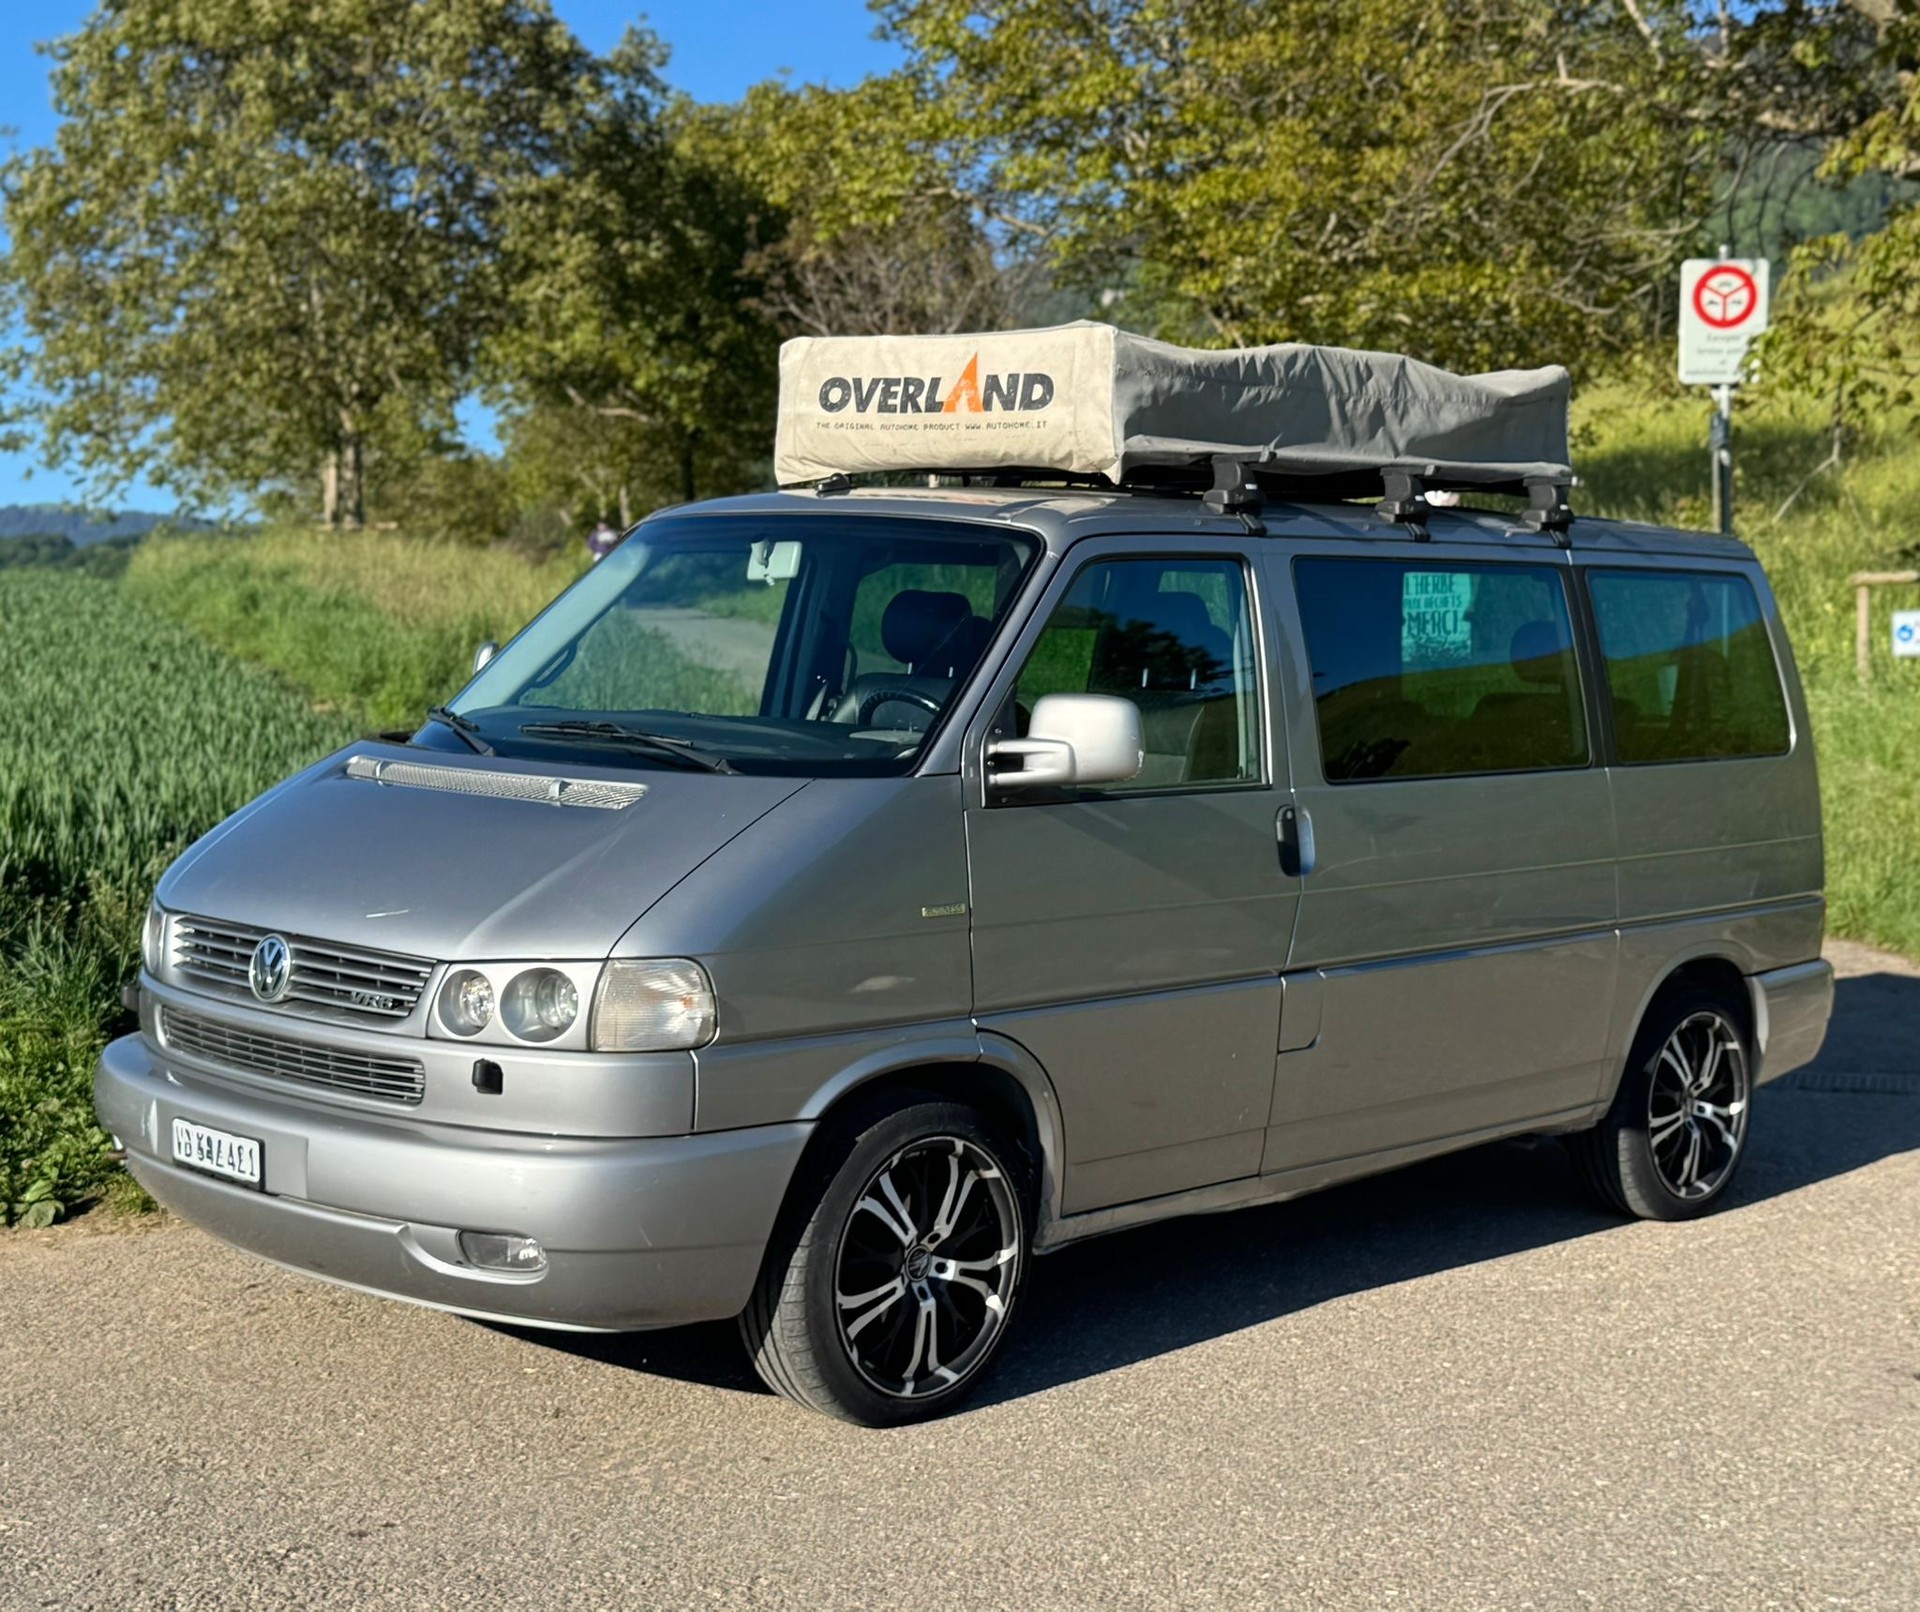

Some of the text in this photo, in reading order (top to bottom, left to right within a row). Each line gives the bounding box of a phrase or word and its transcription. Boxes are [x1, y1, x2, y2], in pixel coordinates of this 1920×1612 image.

[819, 352, 1055, 414] OVERLAND
[816, 421, 831, 430] THE
[833, 421, 876, 431] ORIGINAL
[922, 422, 961, 431] PRODUCT
[1407, 609, 1459, 635] MERCI
